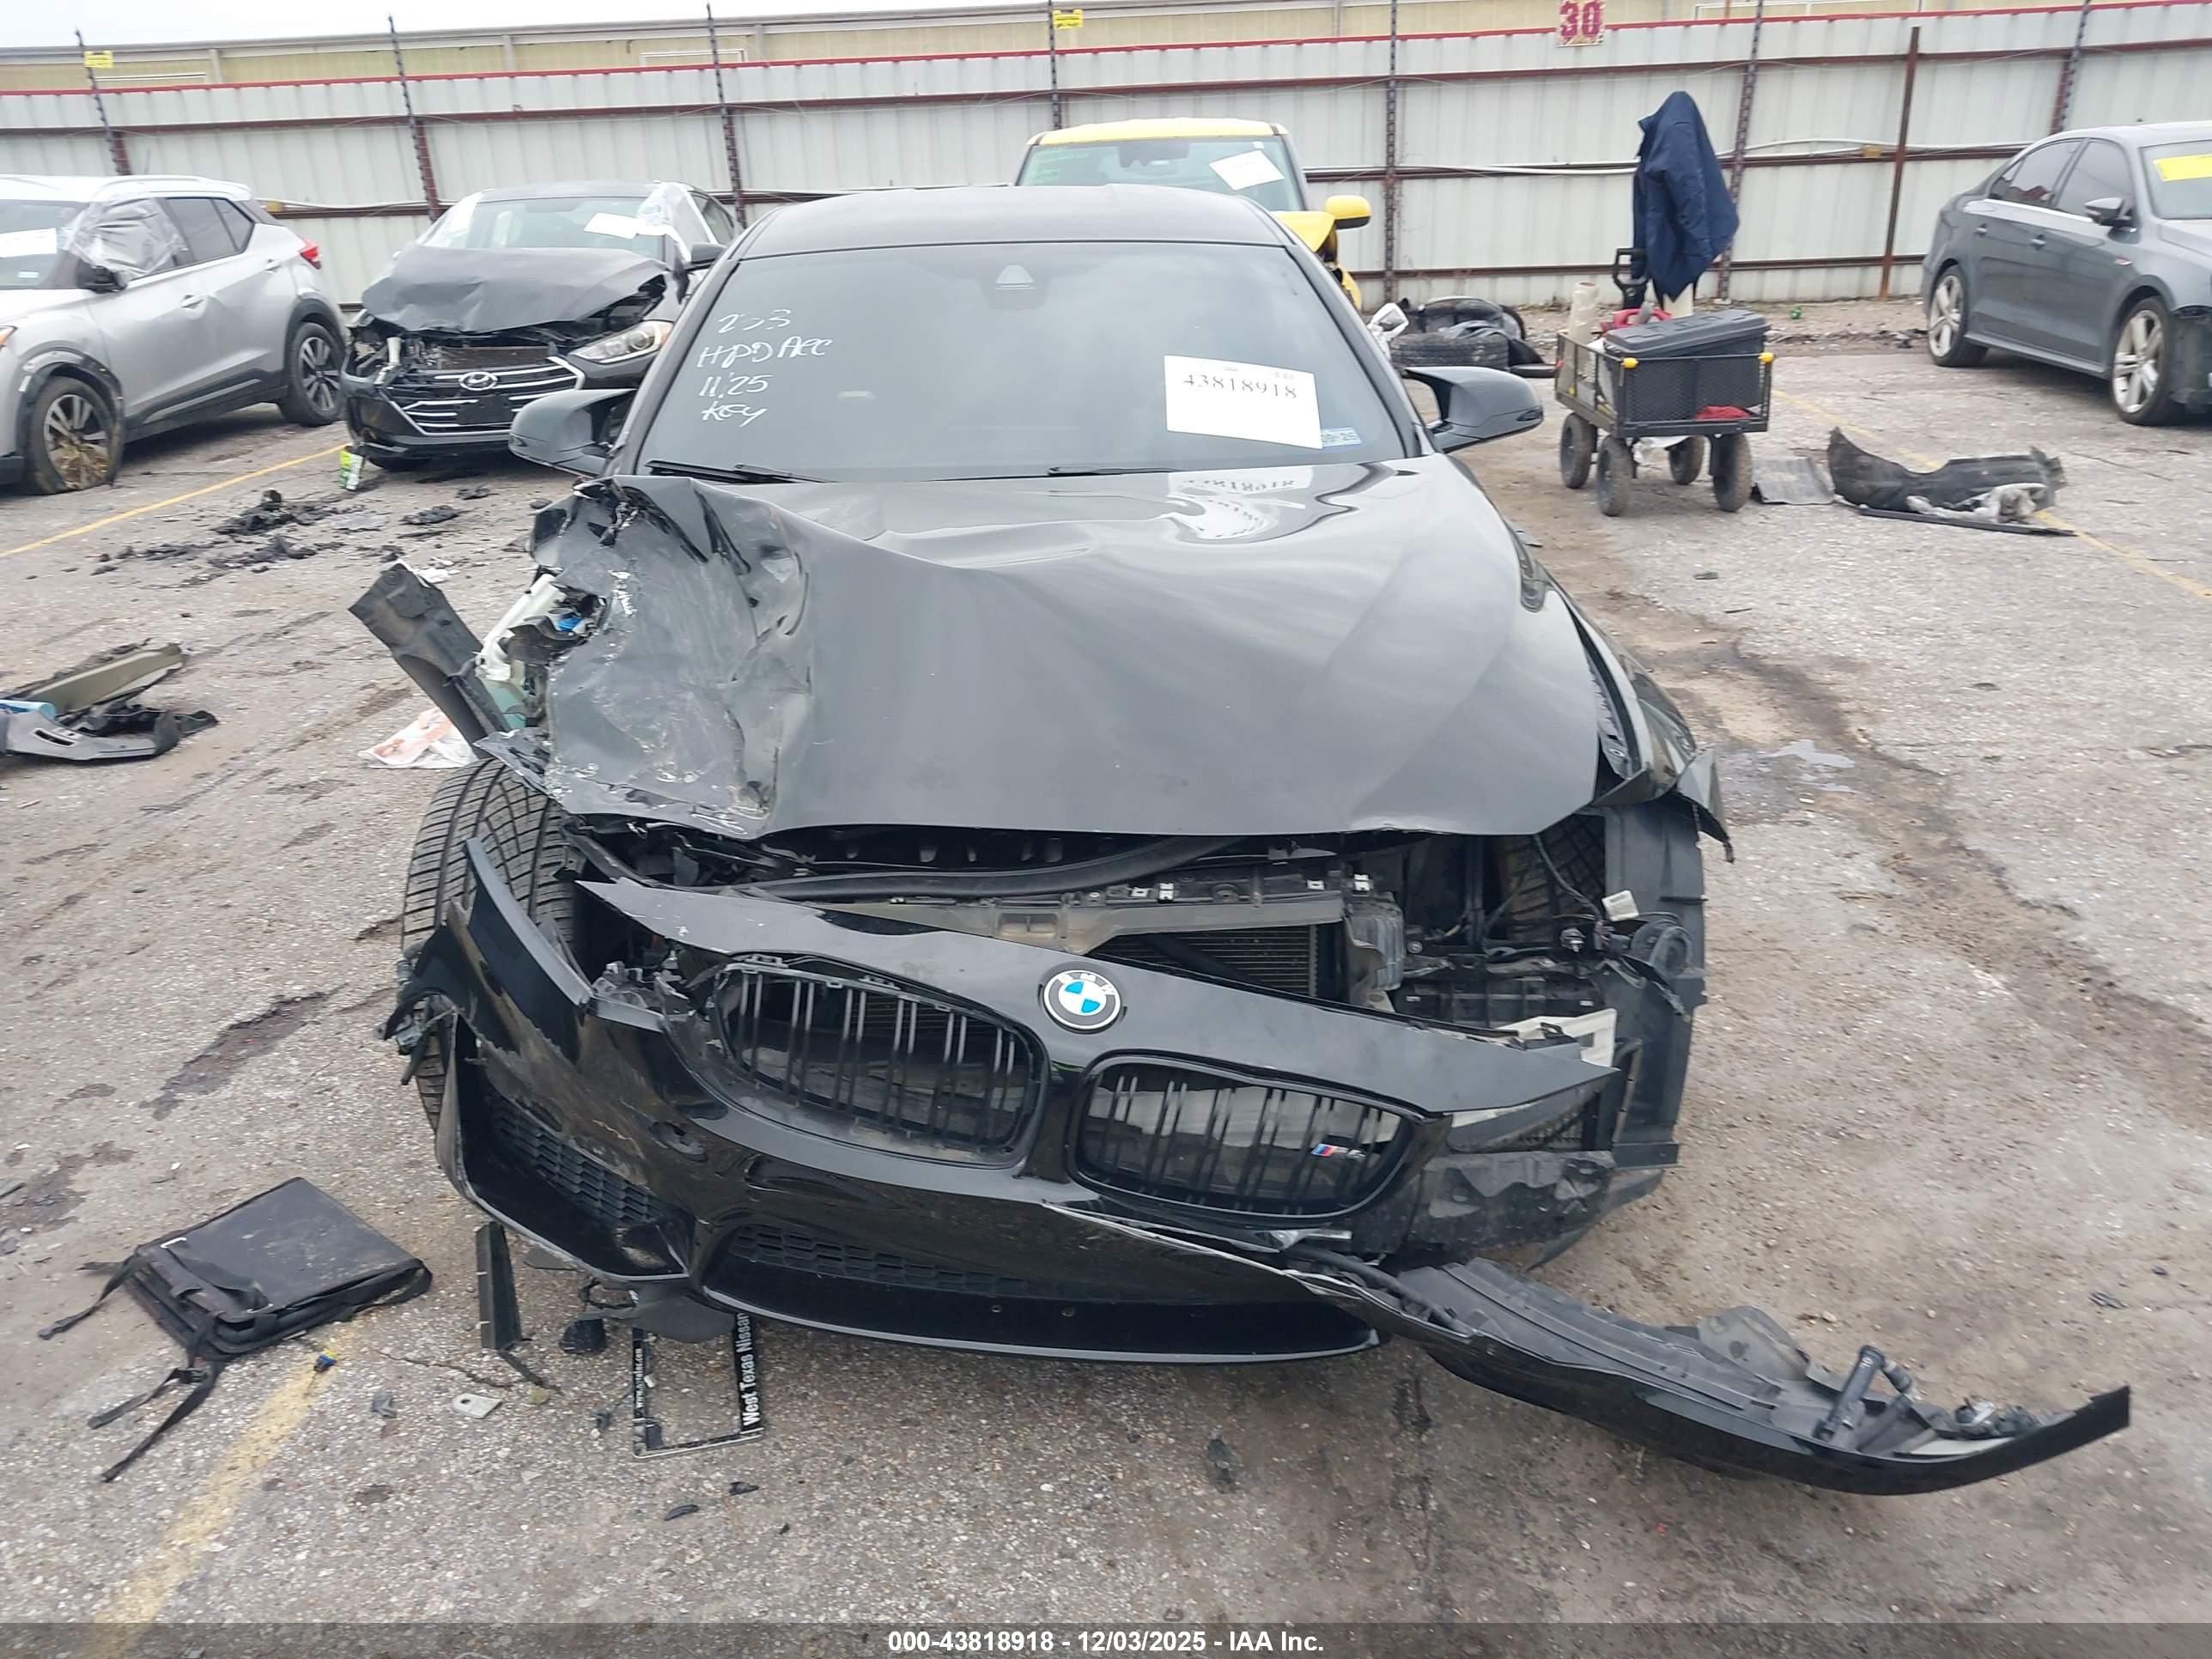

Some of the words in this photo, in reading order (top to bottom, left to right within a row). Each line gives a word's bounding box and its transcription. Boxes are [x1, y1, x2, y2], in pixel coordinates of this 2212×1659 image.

[1559, 0, 1602, 37] 30
[1182, 374, 1297, 399] 43818918
[1057, 972, 1117, 995] BMW
[739, 1353, 757, 1391] Texas
[742, 1390, 761, 1426] West
